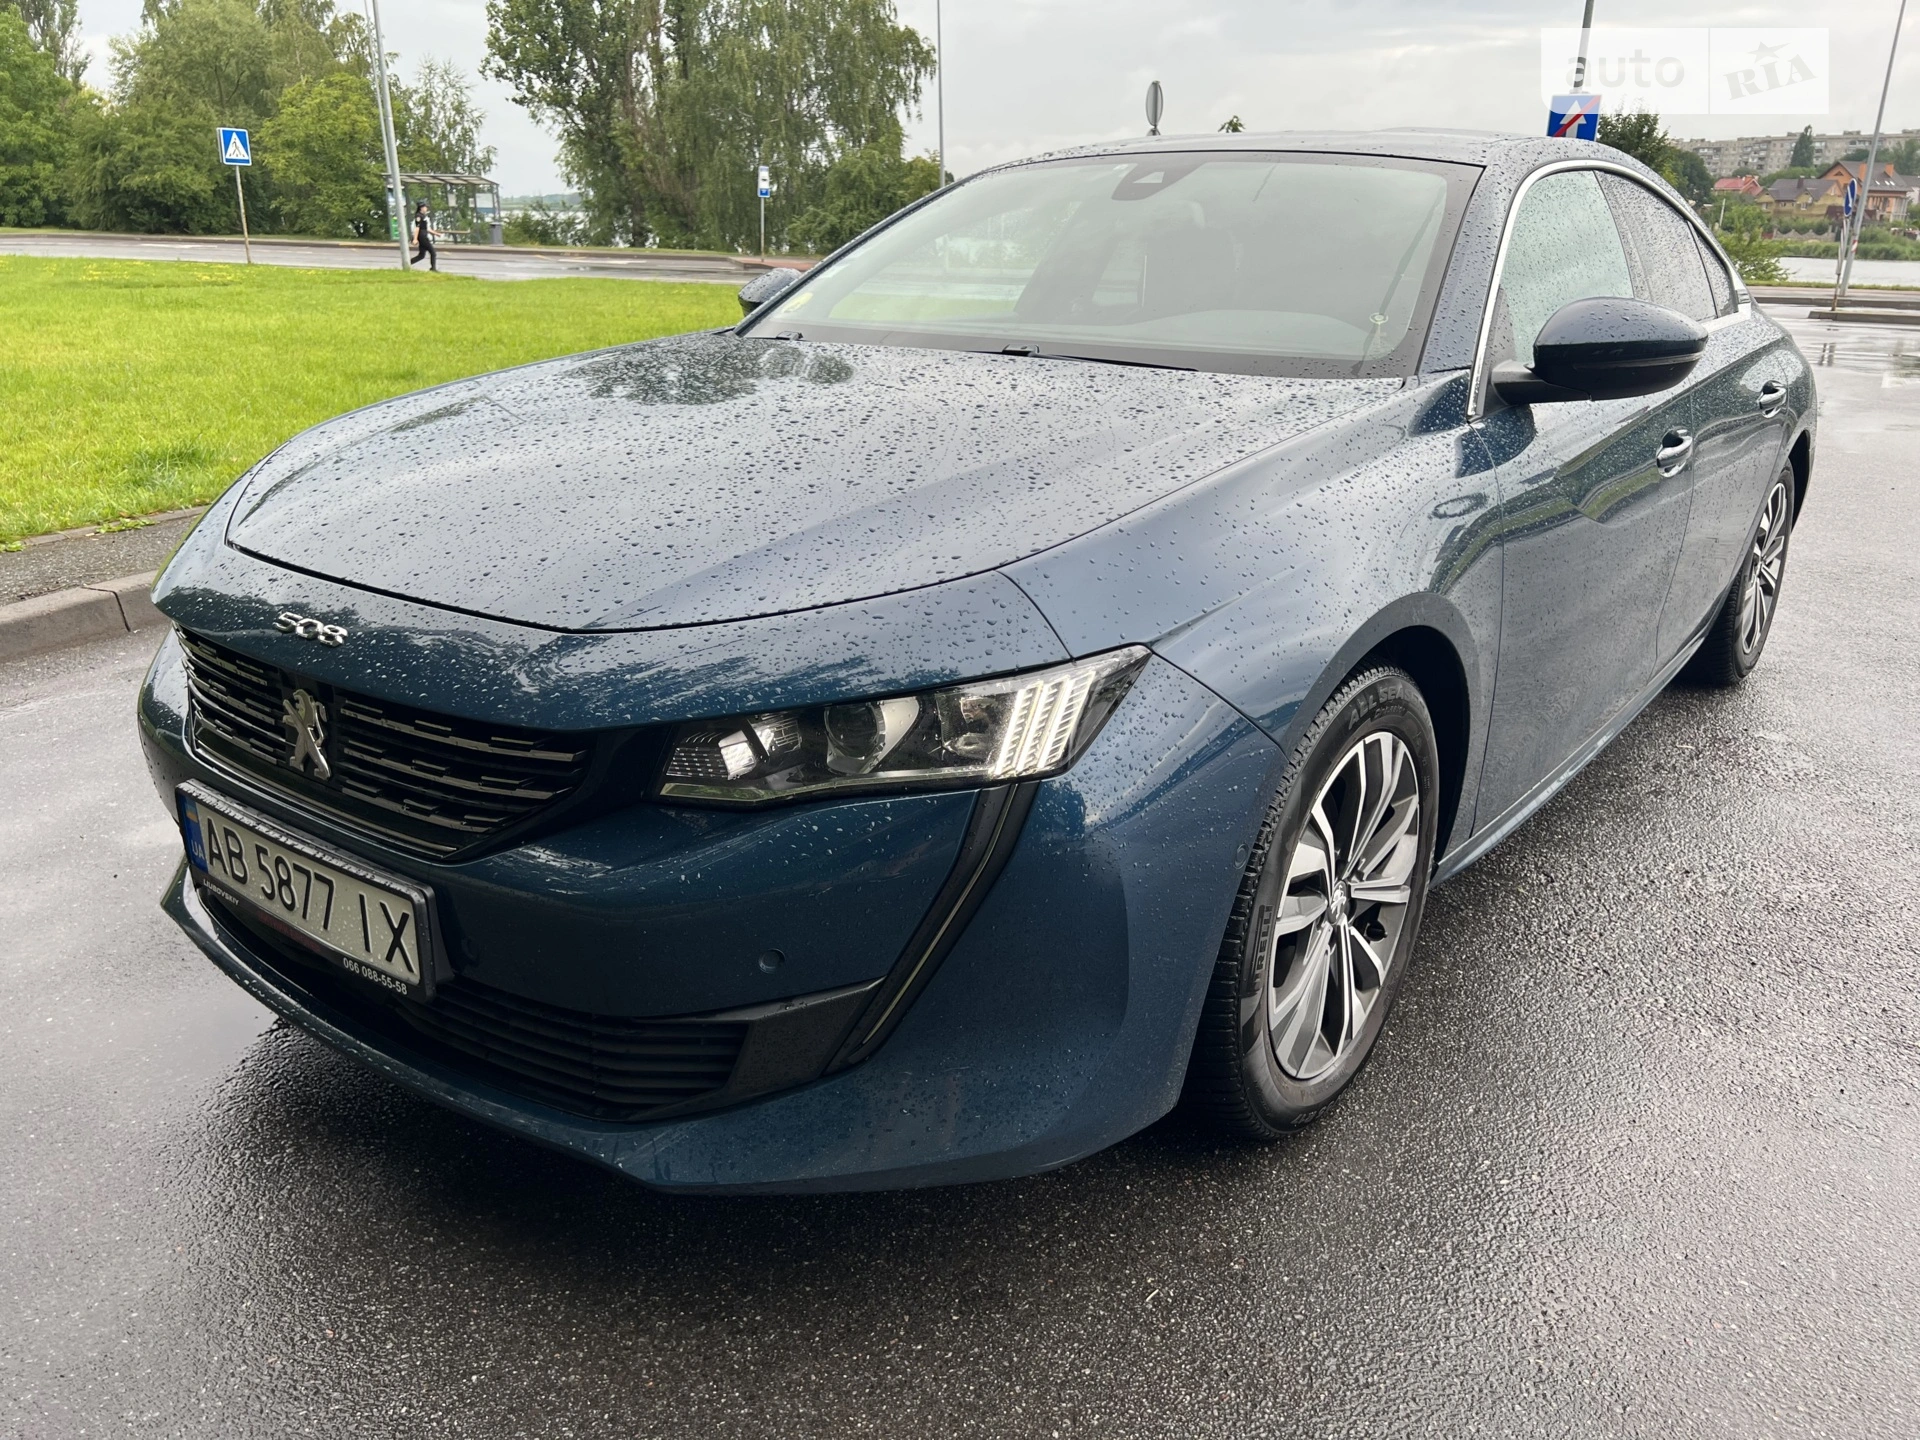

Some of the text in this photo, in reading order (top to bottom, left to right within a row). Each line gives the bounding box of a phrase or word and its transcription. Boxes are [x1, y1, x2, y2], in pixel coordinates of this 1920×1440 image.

[272, 611, 349, 648] 508
[190, 839, 205, 861] UA
[207, 817, 249, 885] AB
[255, 844, 336, 931] 5877
[358, 893, 415, 974] IX
[343, 957, 408, 995] 066 088-55-58
